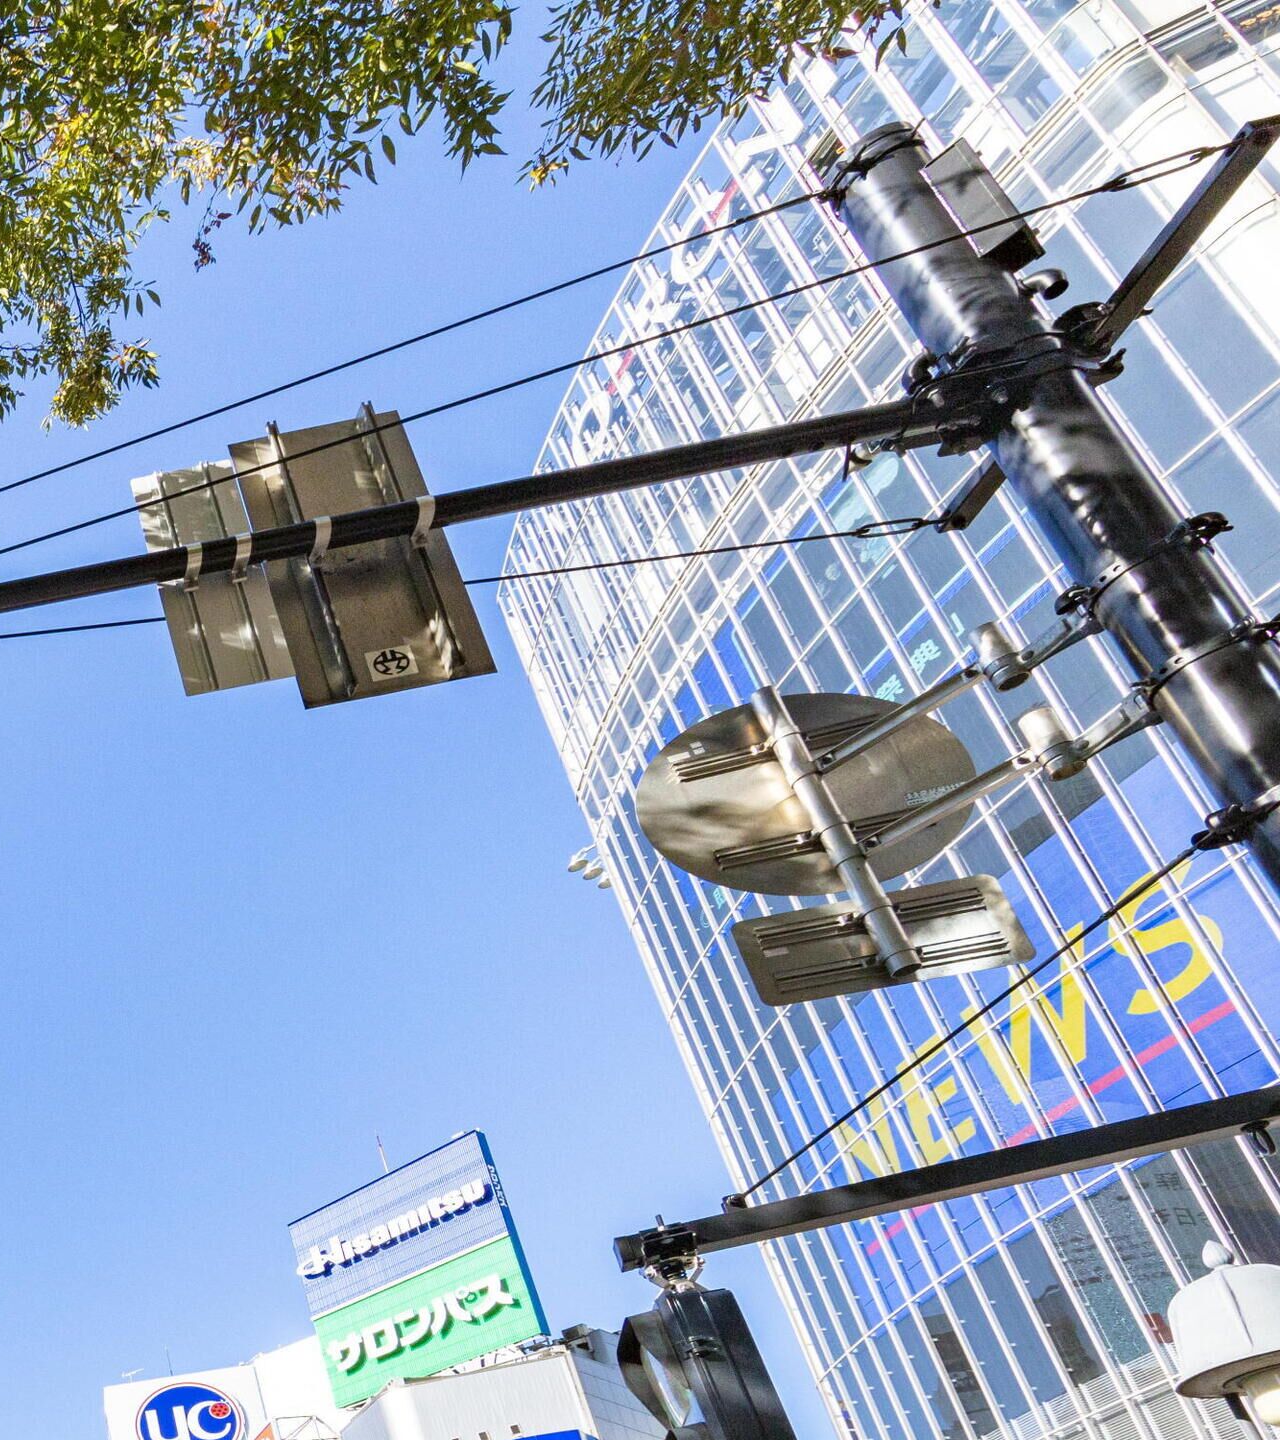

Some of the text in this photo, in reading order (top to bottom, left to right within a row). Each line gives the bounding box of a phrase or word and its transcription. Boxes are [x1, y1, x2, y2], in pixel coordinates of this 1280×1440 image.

[297, 1177, 487, 1277] Hisamitsu
[326, 1273, 522, 1374] サロンパス
